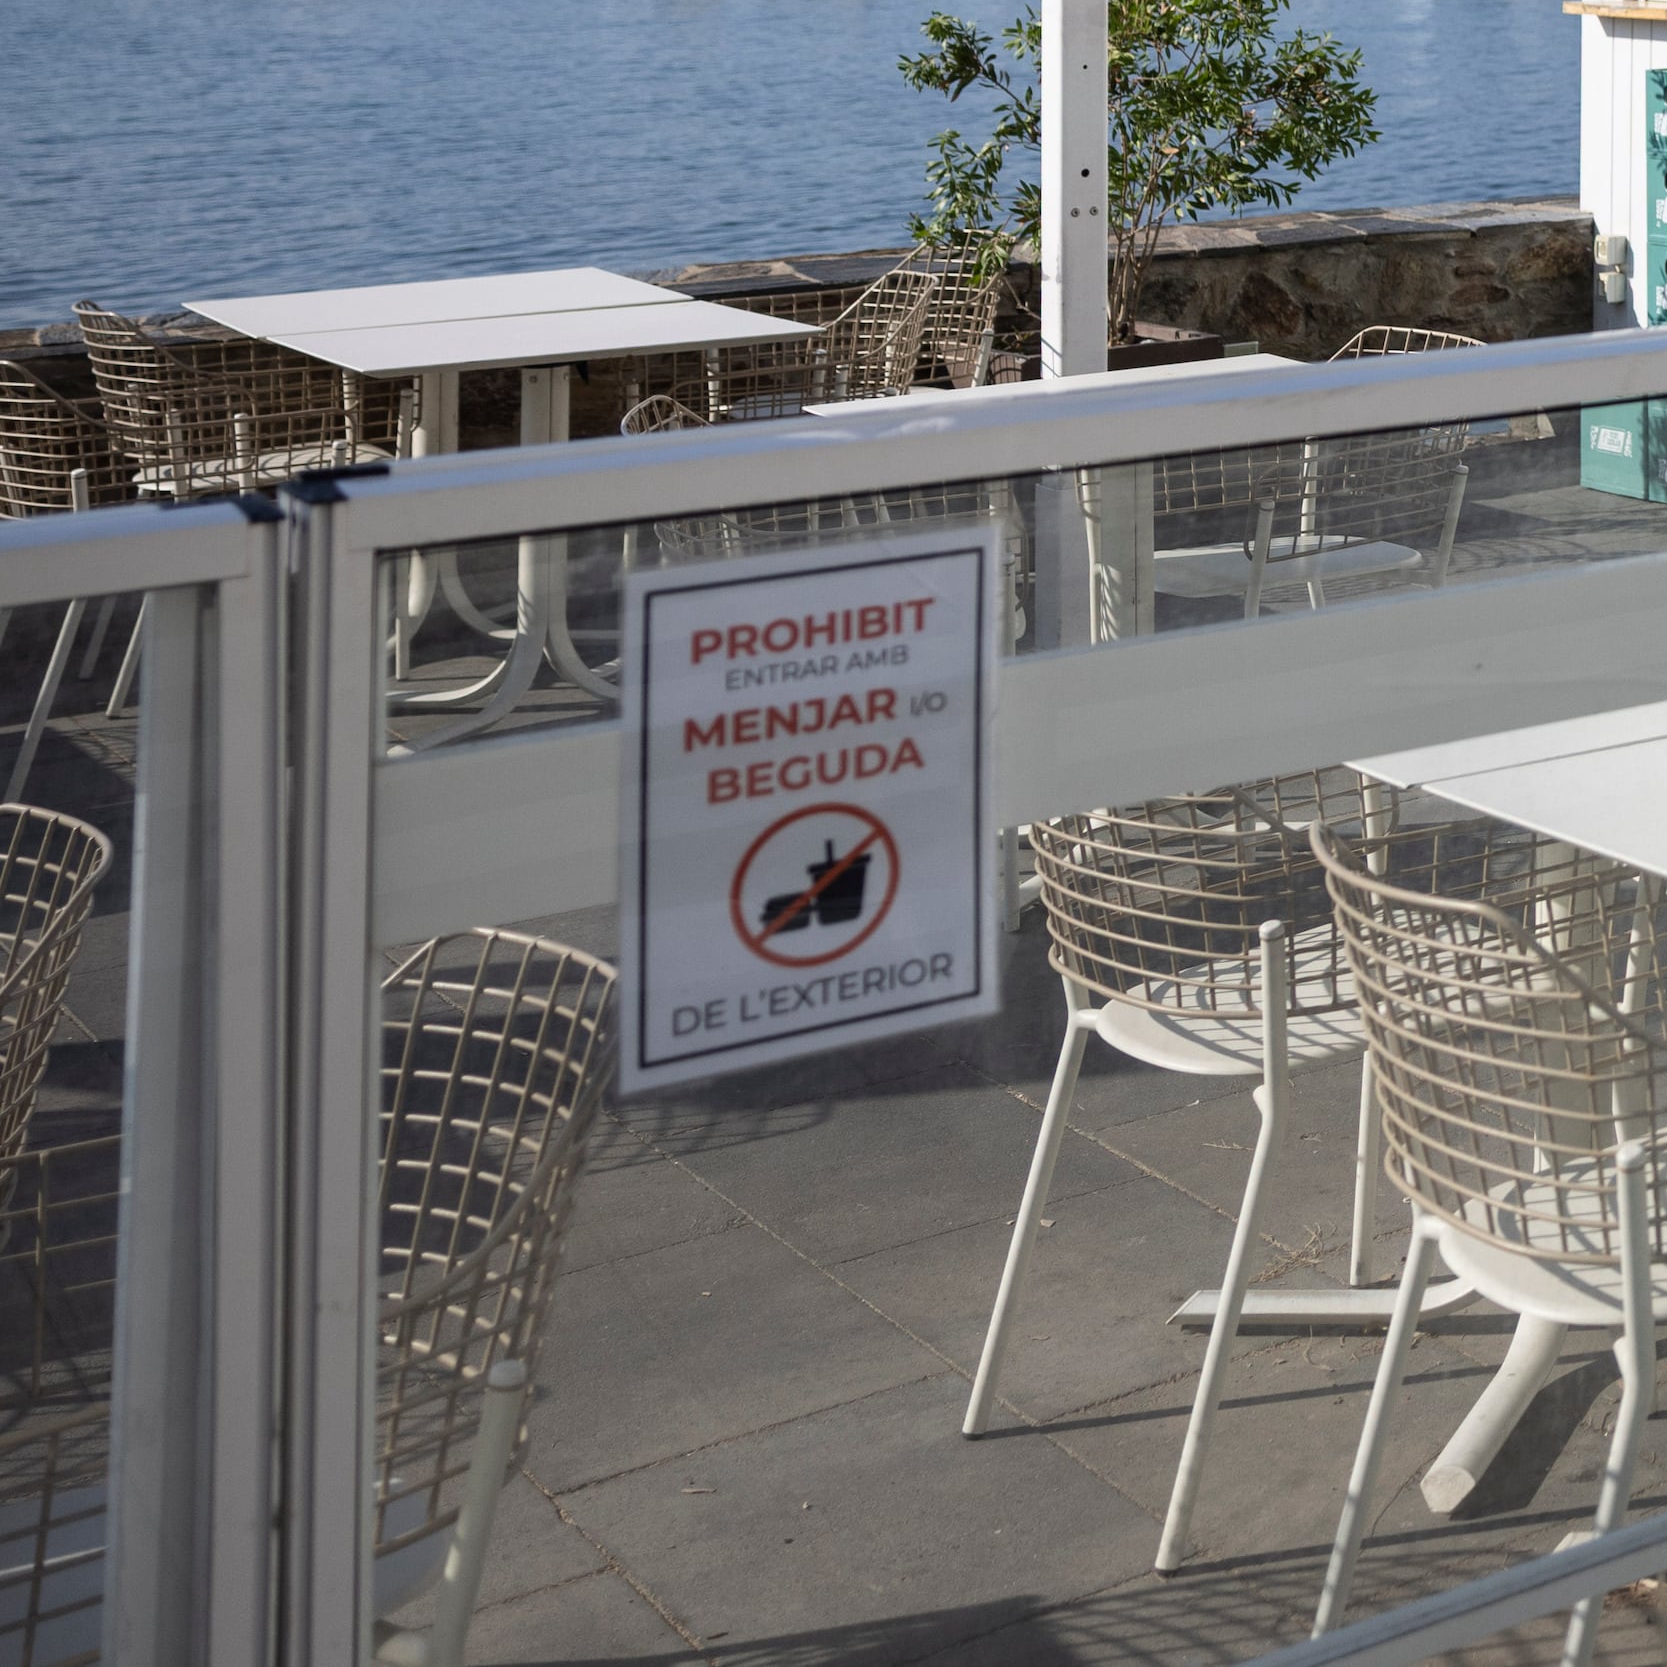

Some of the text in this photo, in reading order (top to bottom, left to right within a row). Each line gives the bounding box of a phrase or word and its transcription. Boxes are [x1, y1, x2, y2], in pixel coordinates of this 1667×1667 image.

[689, 597, 935, 665] PROHIBIT
[724, 644, 910, 692] ENTRAR AMB
[682, 687, 897, 754] MENJAR
[706, 737, 926, 805] BEGUDA
[672, 953, 955, 1037] DE L'EXTERIOR
